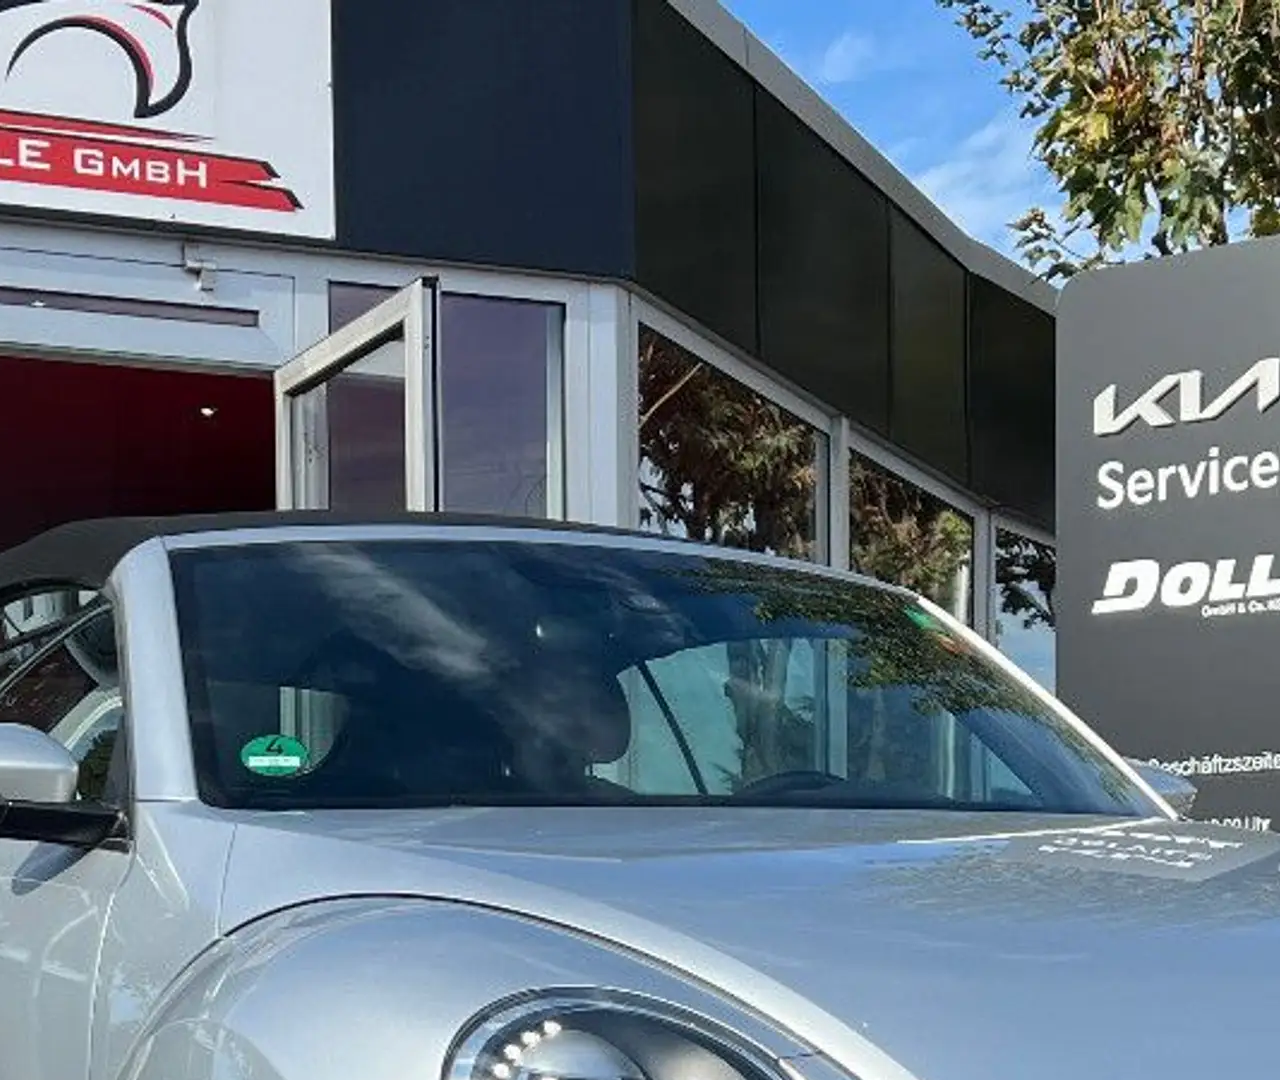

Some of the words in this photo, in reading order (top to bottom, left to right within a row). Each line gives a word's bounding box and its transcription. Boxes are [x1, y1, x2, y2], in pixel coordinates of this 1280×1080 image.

[1093, 356, 1280, 437] KIA
[1097, 447, 1280, 509] Service
[265, 736, 284, 755] 4
